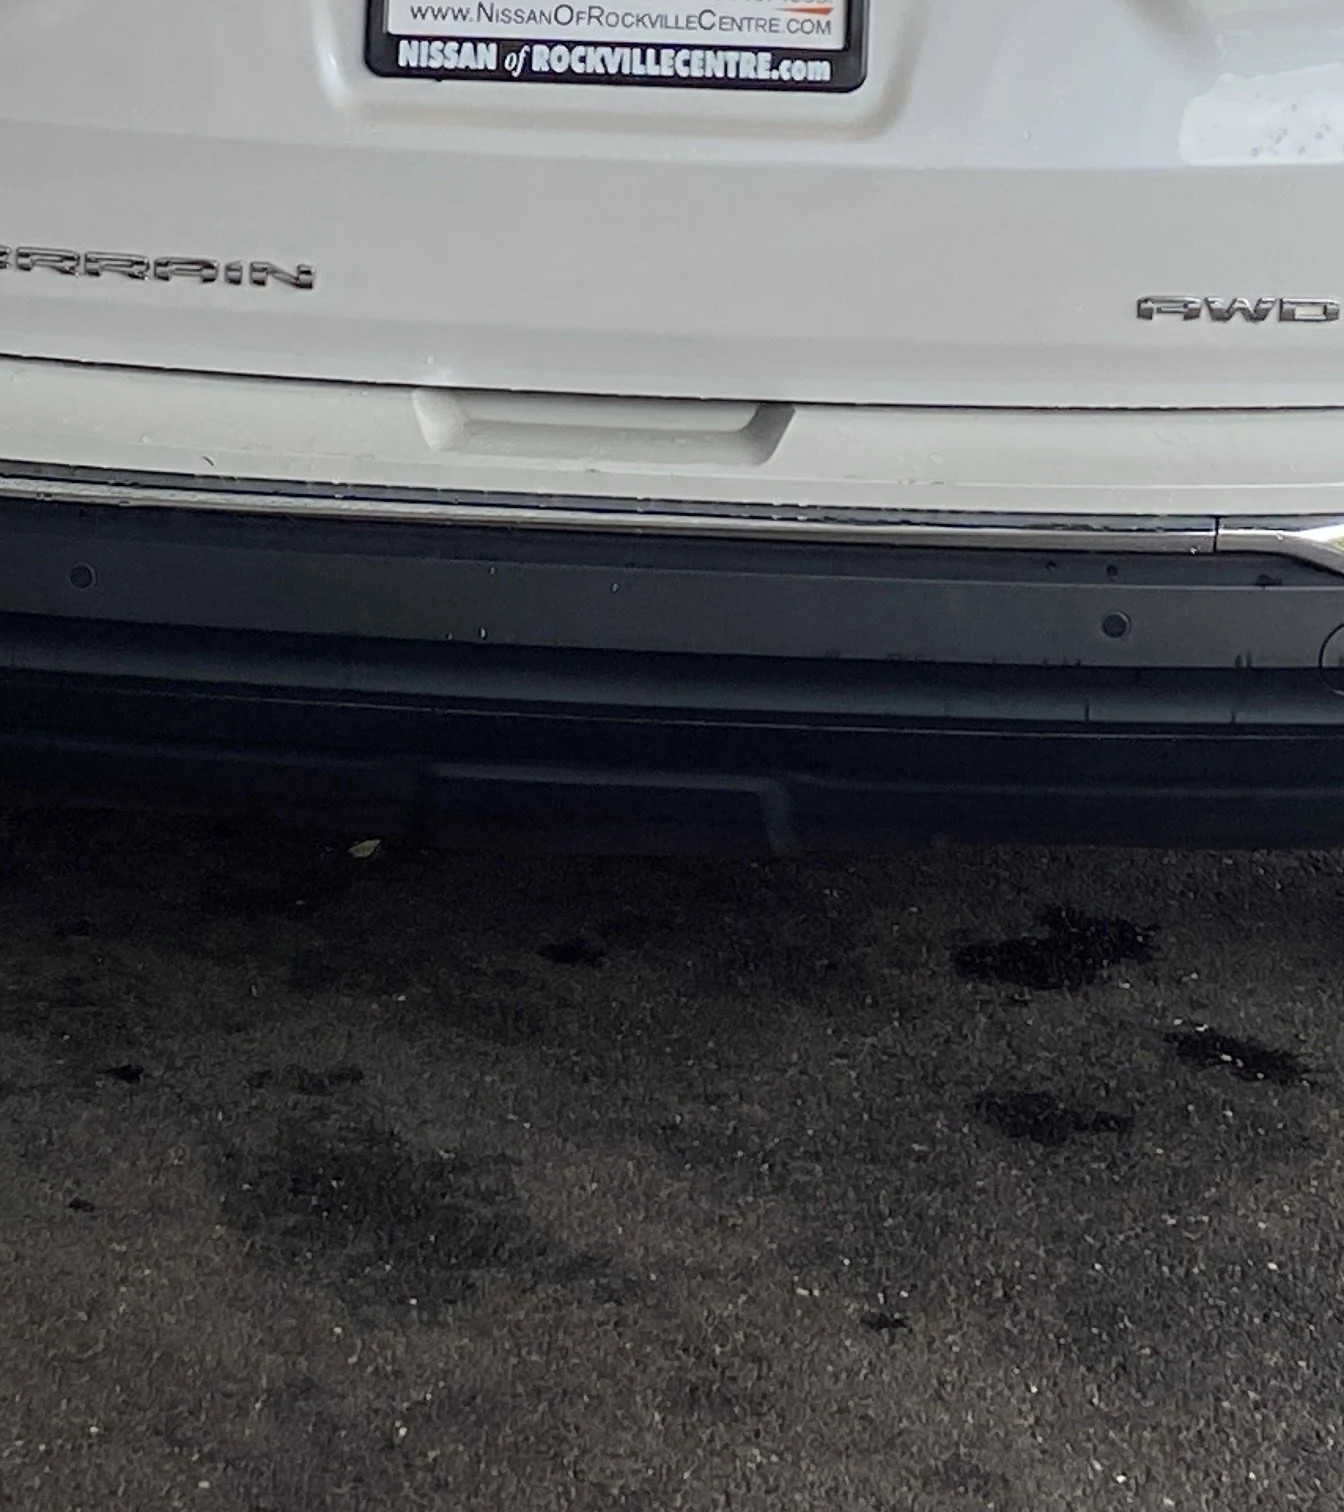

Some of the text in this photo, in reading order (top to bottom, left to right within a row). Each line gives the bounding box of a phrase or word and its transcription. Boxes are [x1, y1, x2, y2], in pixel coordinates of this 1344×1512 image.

[398, 39, 831, 82] NISSAN of ROCKVILLECENTRE.com
[1136, 294, 1342, 323] AWD
